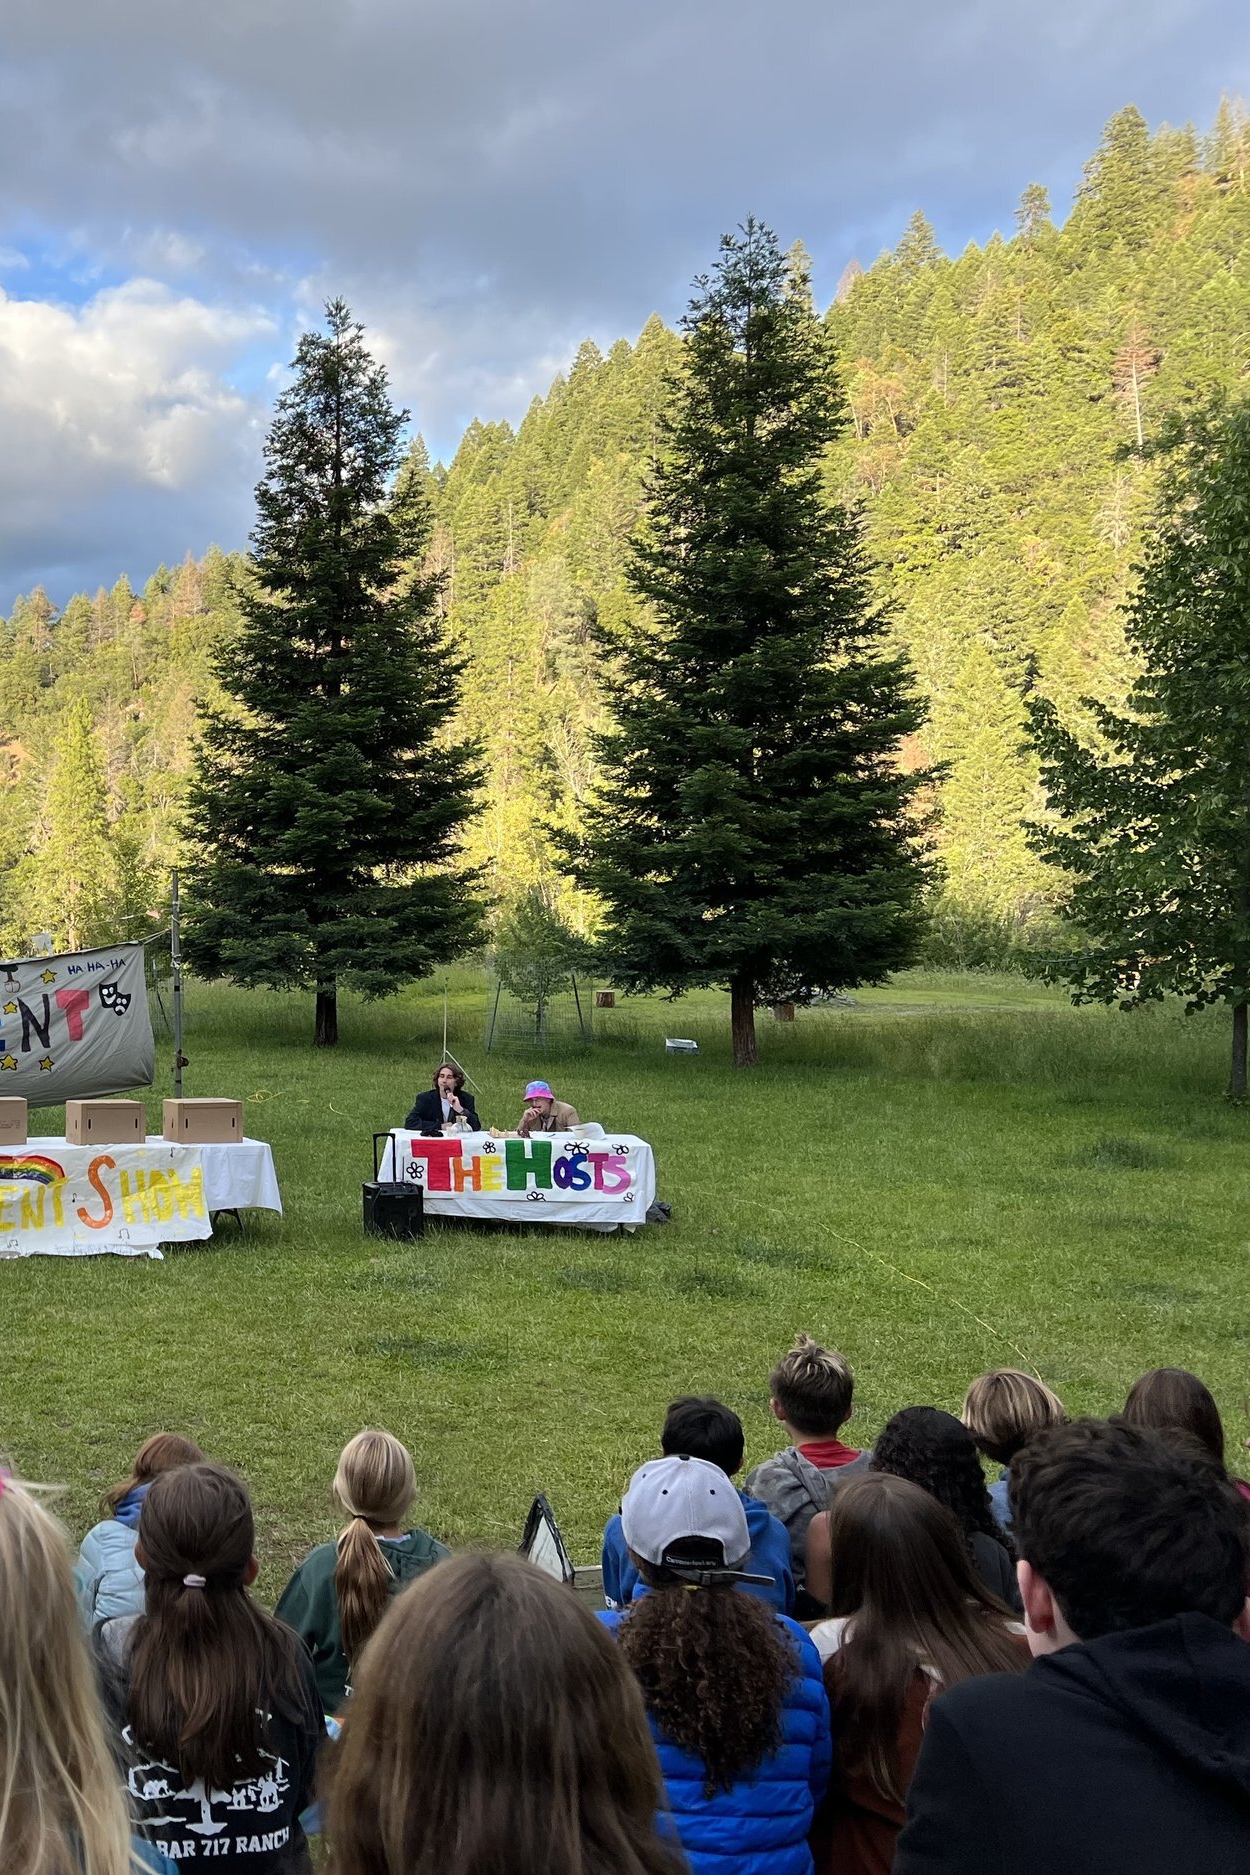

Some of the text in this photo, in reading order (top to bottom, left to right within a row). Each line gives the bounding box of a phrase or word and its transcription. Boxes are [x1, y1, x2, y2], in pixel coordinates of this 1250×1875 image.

[77, 1155, 205, 1230] SHOW
[410, 1139, 632, 1195] THE HOSTS
[156, 1840, 196, 1860] BAR
[200, 1838, 231, 1857] 717
[235, 1826, 290, 1854] RANCH
